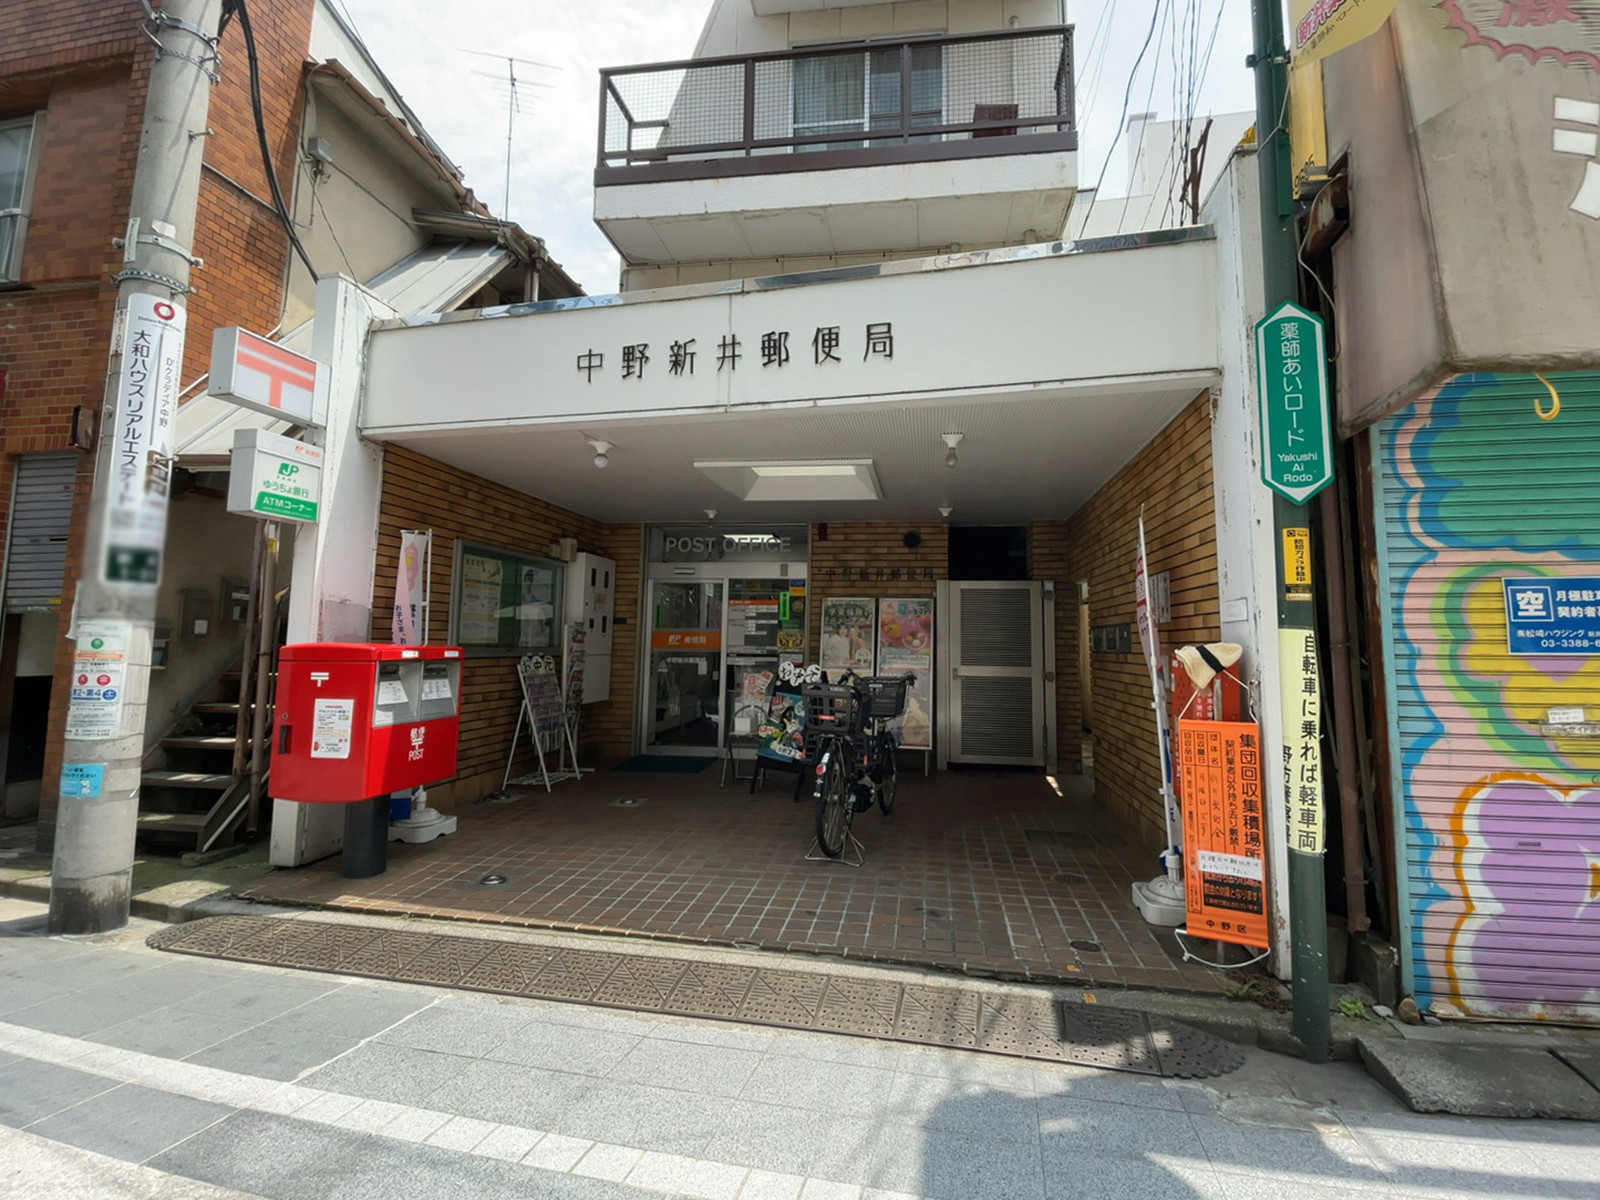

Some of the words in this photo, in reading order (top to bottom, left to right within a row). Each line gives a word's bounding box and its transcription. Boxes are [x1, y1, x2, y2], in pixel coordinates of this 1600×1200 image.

[576, 321, 894, 384] 中野新井郵便局
[1280, 321, 1305, 448] 薬師あいロード
[1277, 452, 1318, 462] Yakushi
[278, 462, 300, 477] JP
[1292, 463, 1304, 472] Ai
[1283, 473, 1313, 483] Rodo
[262, 479, 310, 499] ゆうちょ銀行
[262, 496, 312, 512] ATMコーナー
[665, 537, 716, 553] POST
[722, 537, 792, 553] OFFICE
[1516, 591, 1546, 616] 空
[1557, 606, 1600, 617] 契約者
[1209, 733, 1219, 765] 団体名
[1298, 633, 1318, 852] 自転車に乗れば軽車両
[408, 747, 425, 762] POST
[1239, 733, 1262, 860] 集団回収集積場所
[1206, 919, 1247, 934] 中野区
